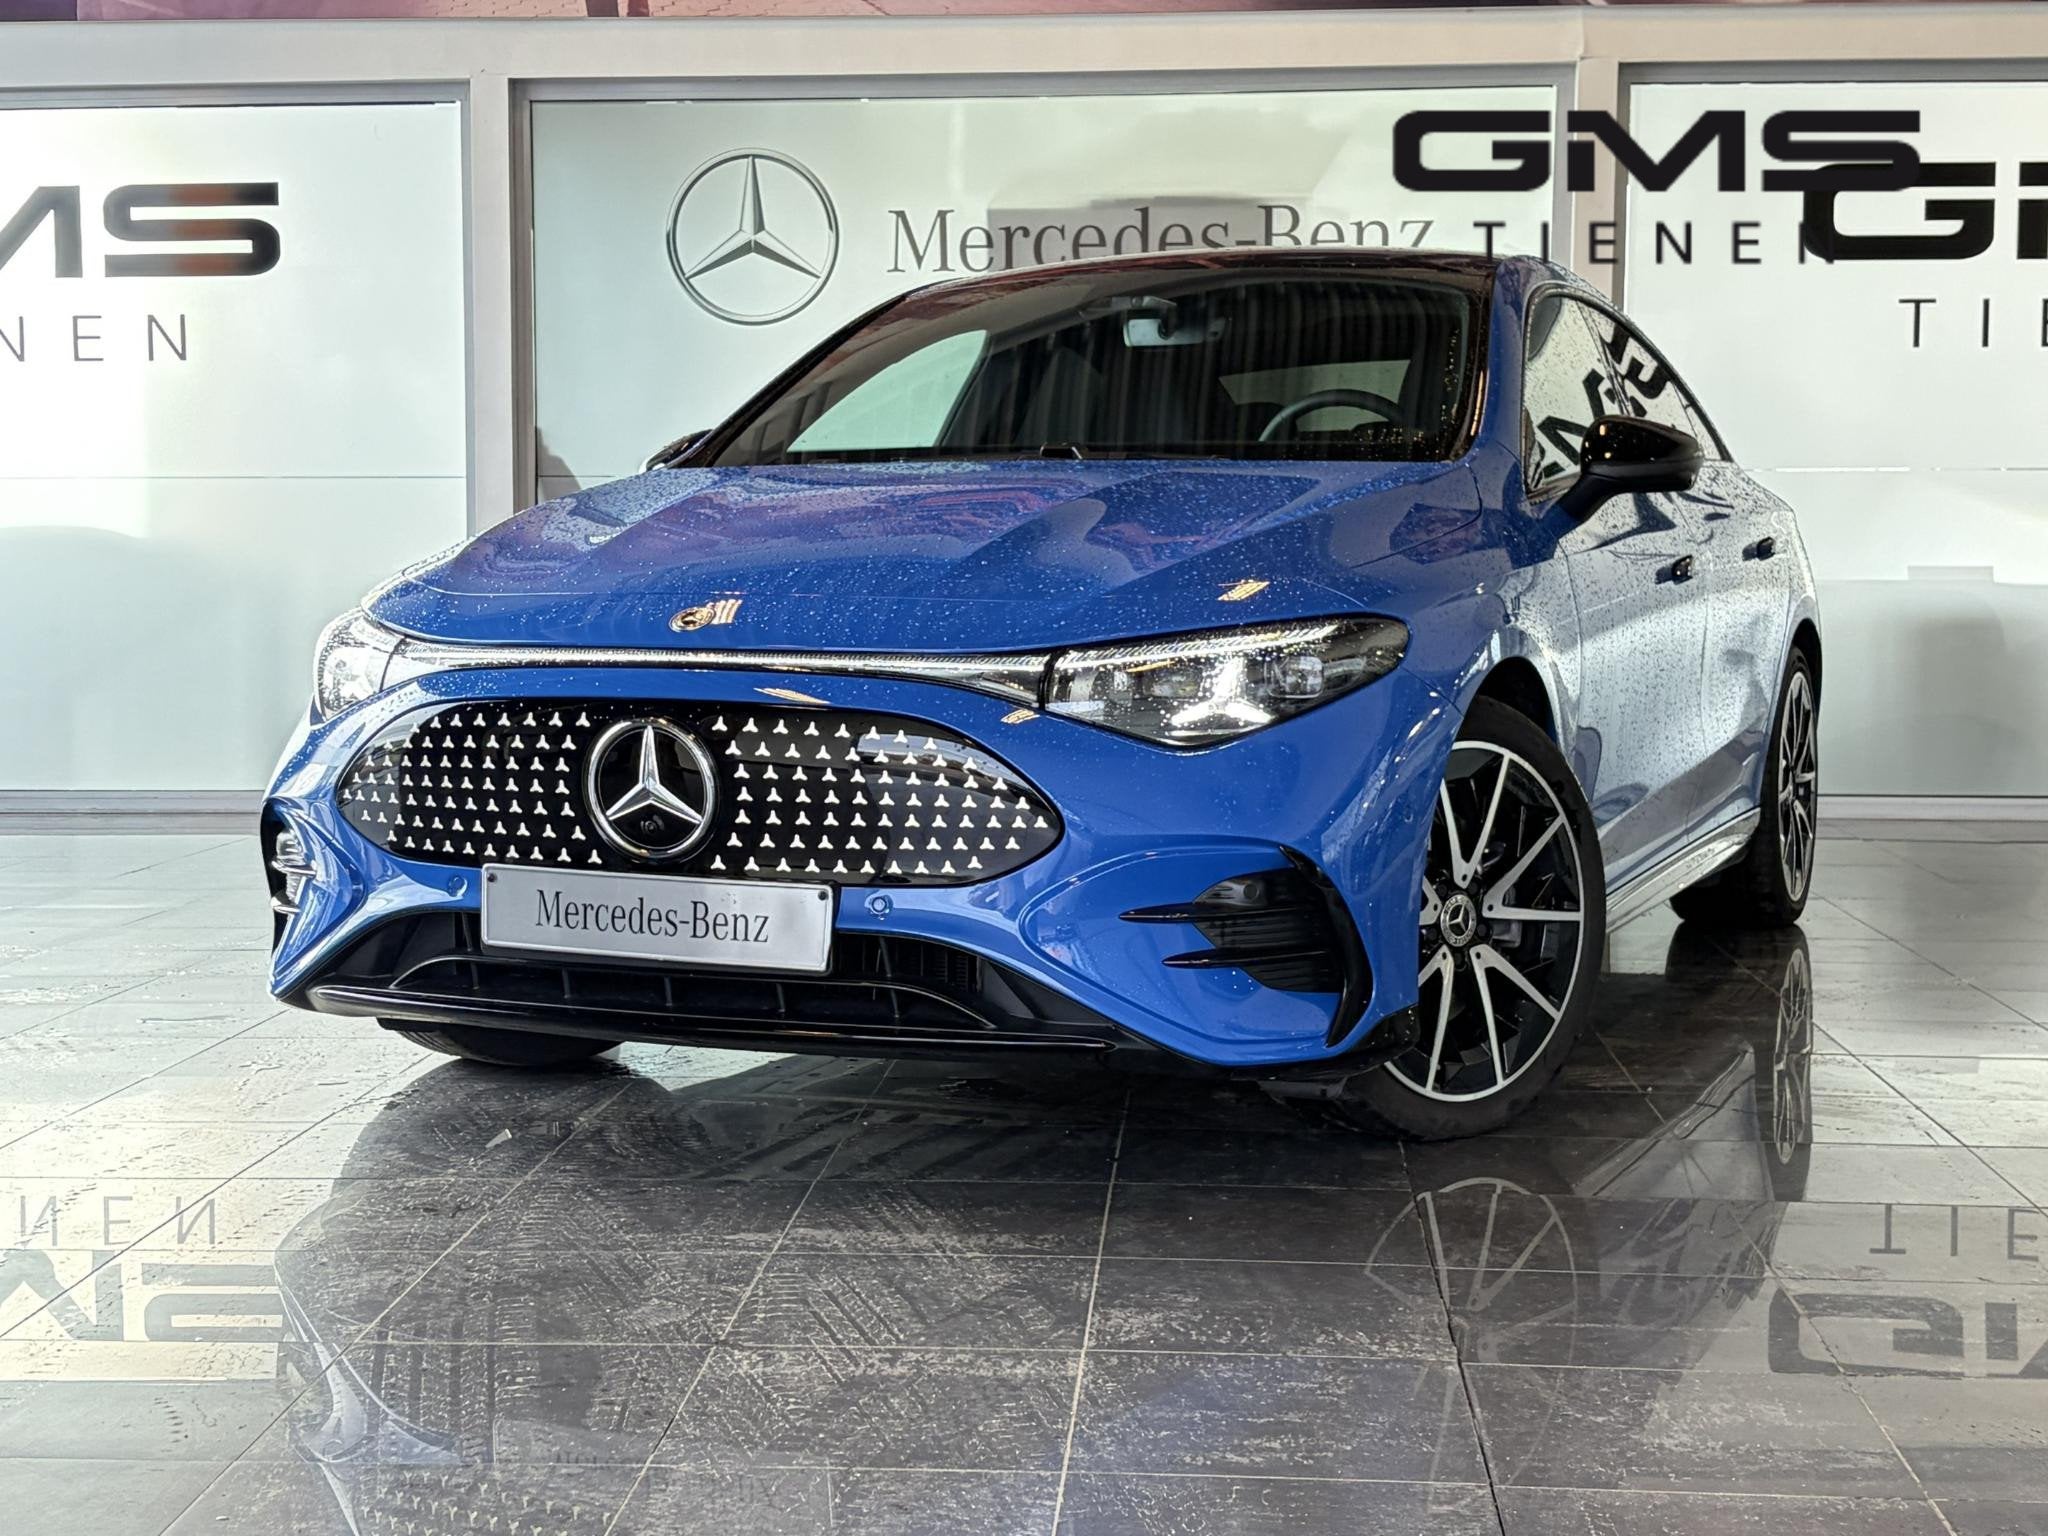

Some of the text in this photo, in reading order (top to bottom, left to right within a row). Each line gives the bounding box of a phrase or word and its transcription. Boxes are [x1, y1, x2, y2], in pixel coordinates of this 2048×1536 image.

[887, 205, 1434, 273] Mercedes-Benz
[1803, 161, 2048, 260] G
[1898, 298, 2048, 347] TI
[535, 889, 769, 943] Mercedes-Benz
